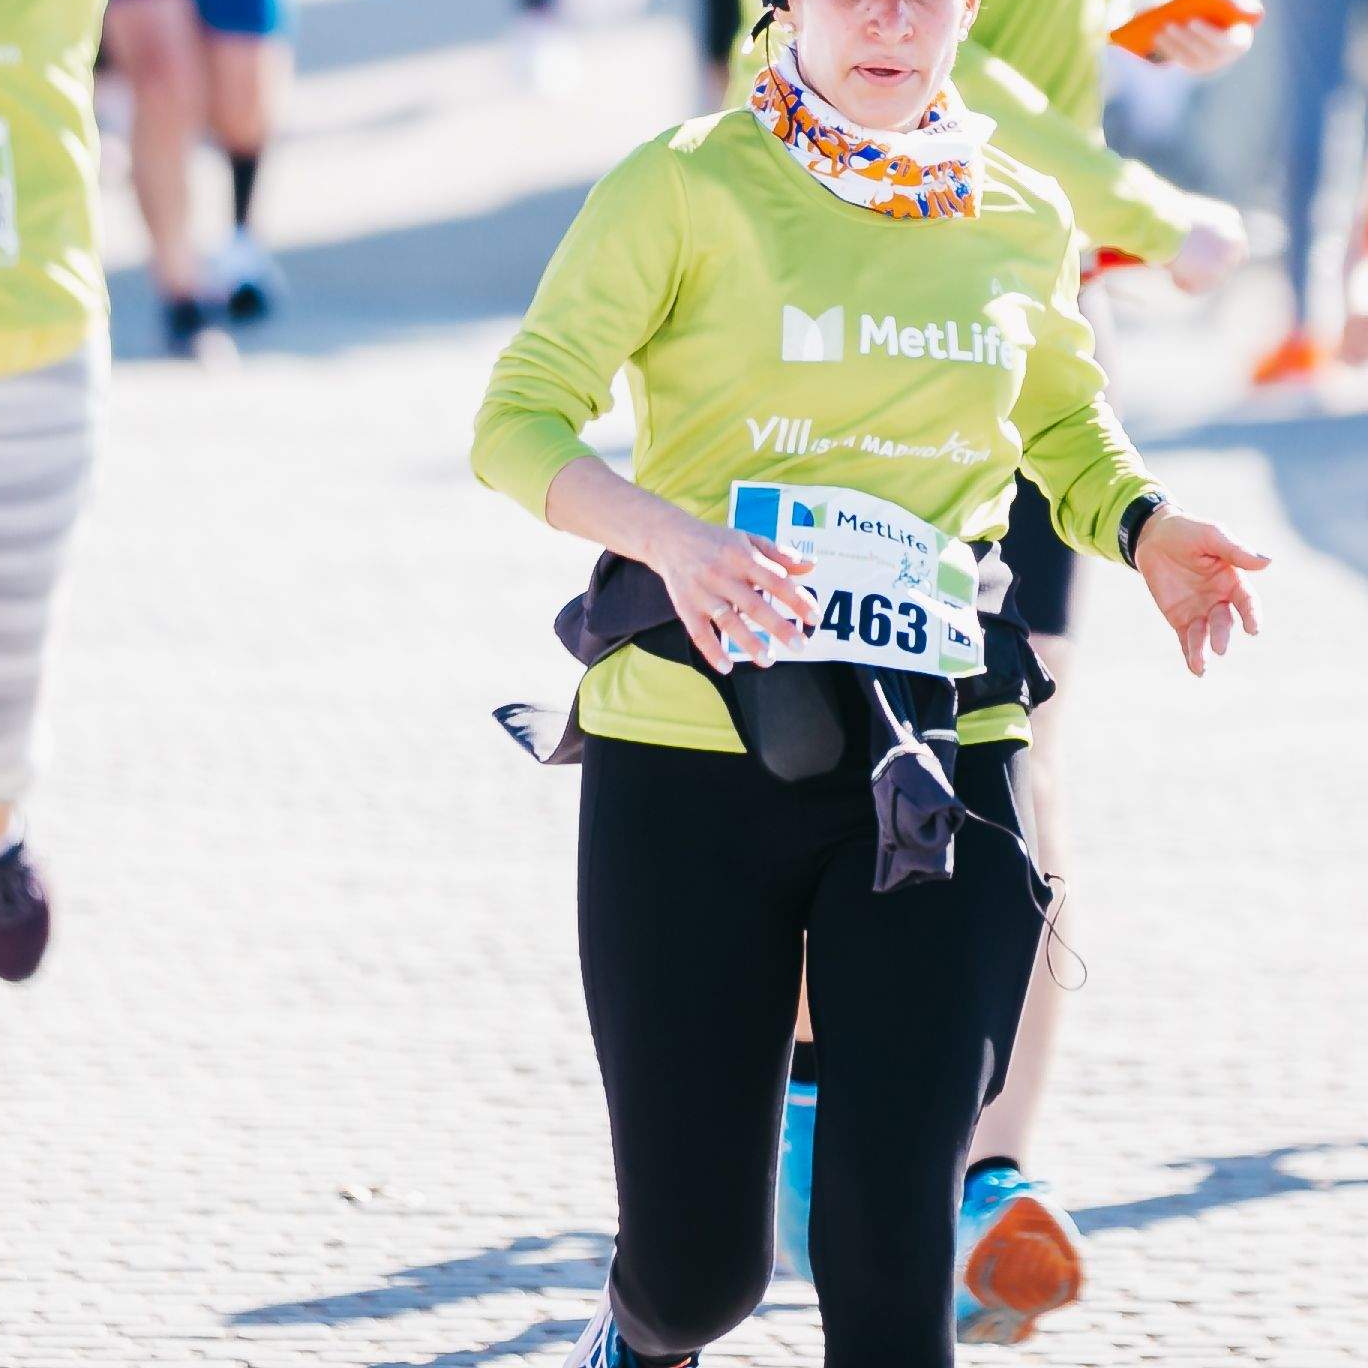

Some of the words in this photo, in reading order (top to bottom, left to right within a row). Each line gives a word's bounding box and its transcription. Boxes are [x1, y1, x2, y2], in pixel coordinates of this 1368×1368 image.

[858, 313, 1016, 370] MetLife
[745, 415, 813, 455] VIII
[836, 510, 928, 555] MetLife
